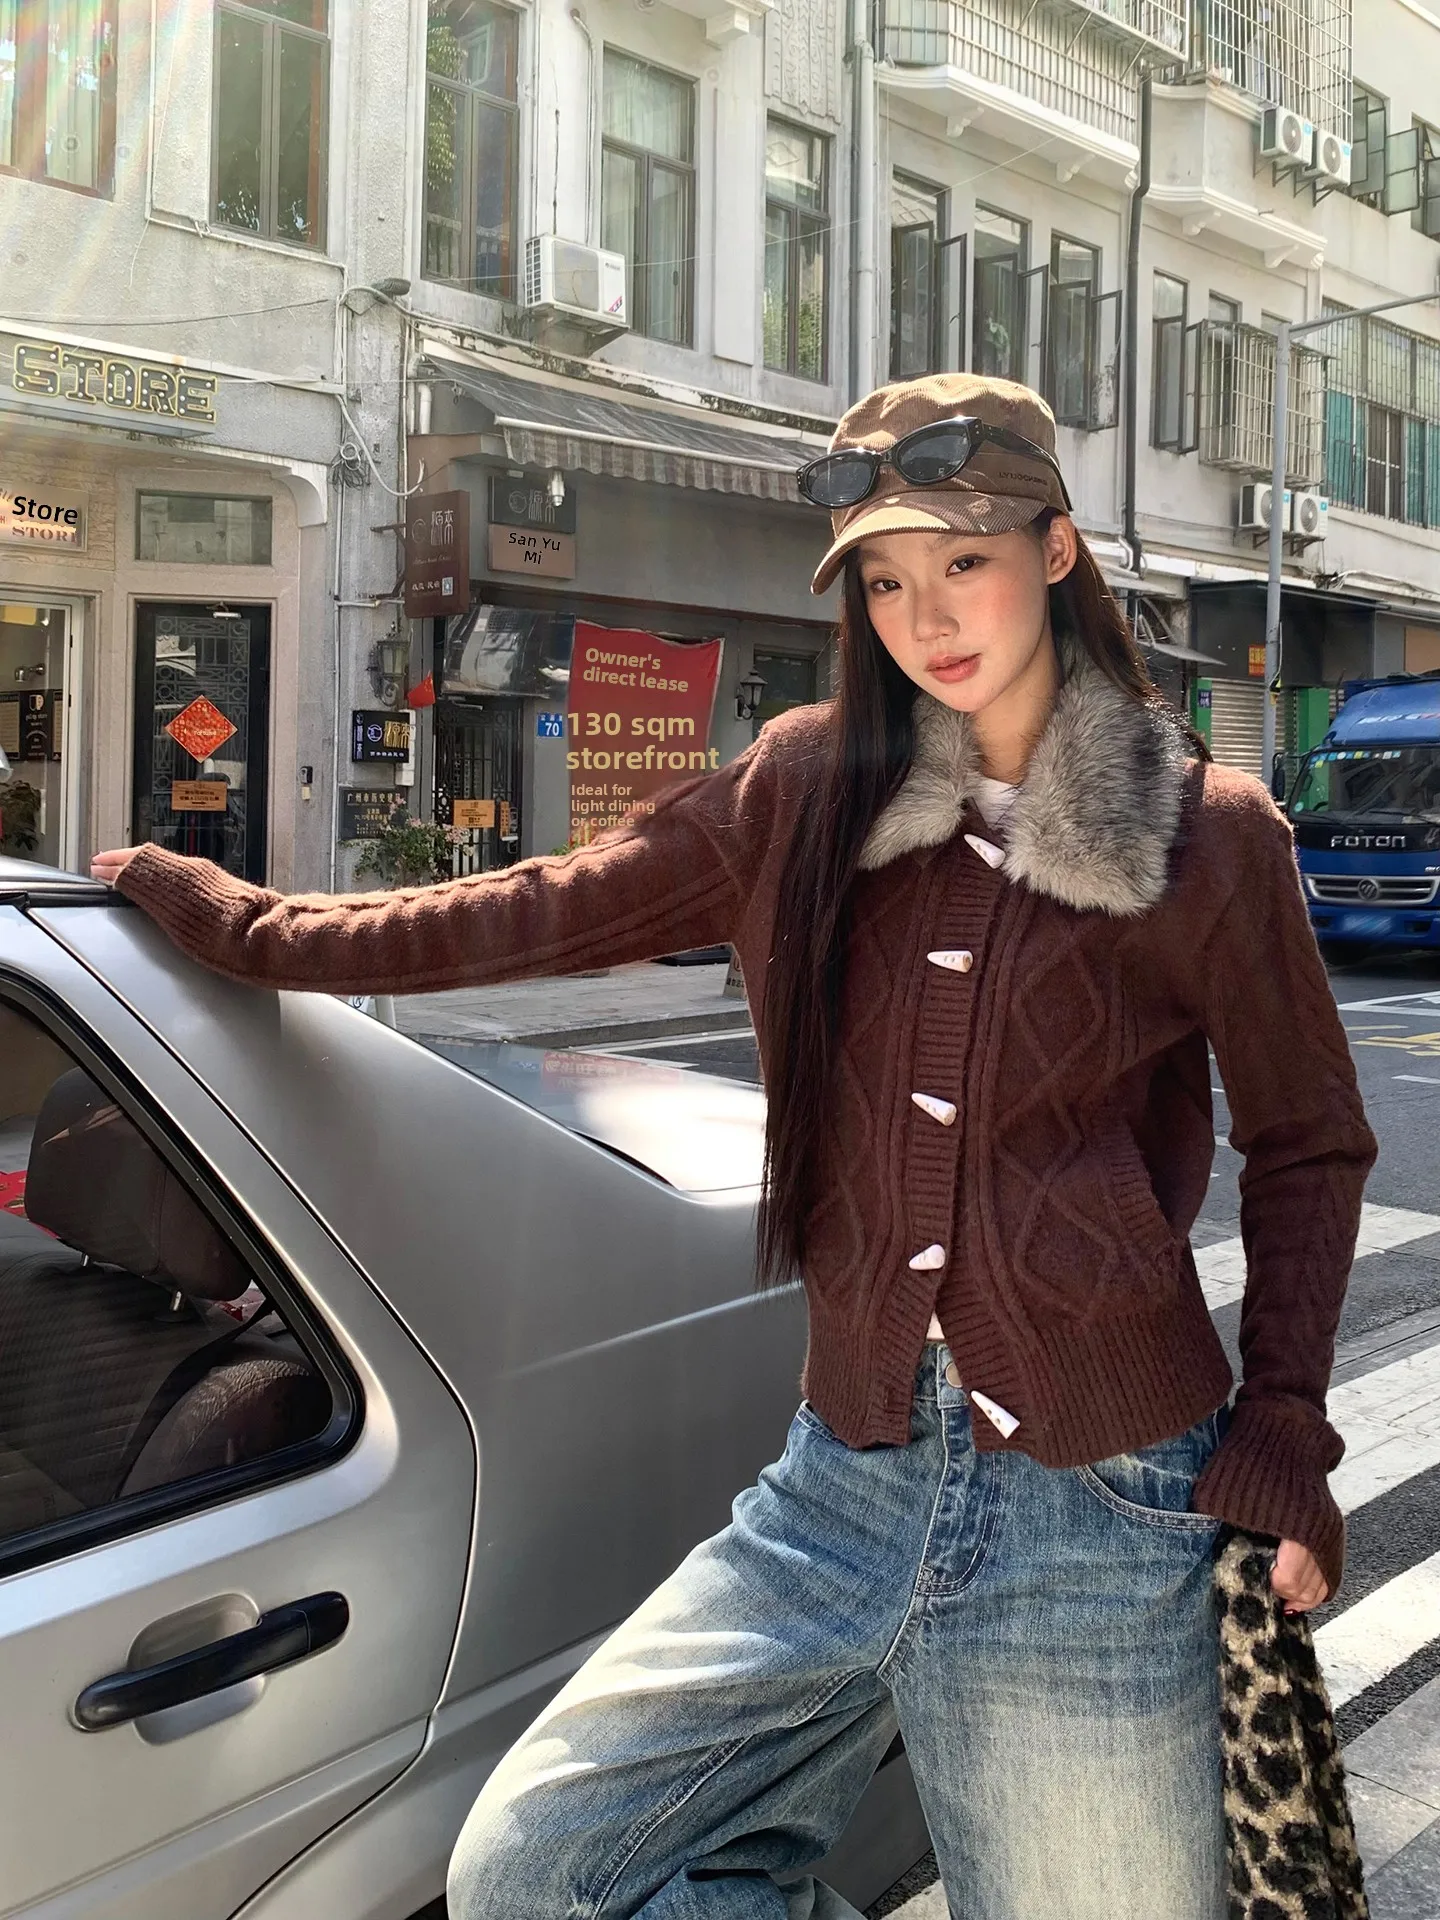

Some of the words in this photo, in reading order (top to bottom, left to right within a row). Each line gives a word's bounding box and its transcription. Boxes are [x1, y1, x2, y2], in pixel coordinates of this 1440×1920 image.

[13, 343, 218, 423] STORE
[12, 496, 78, 524] Store
[509, 532, 537, 547] San
[542, 537, 561, 551] Yu
[524, 551, 542, 564] Mi
[585, 647, 661, 670] Owner's
[583, 666, 636, 687] direct
[640, 672, 689, 692] lease
[545, 722, 560, 736] 70
[568, 712, 622, 736] 130
[631, 717, 695, 746] sqm
[566, 745, 720, 770] storefront
[571, 784, 608, 796] Ideal
[612, 784, 633, 796] for
[571, 800, 605, 815] light
[608, 800, 656, 815] dining
[571, 818, 586, 827] or
[590, 815, 635, 827] coffee
[1331, 835, 1406, 848] FOTON
